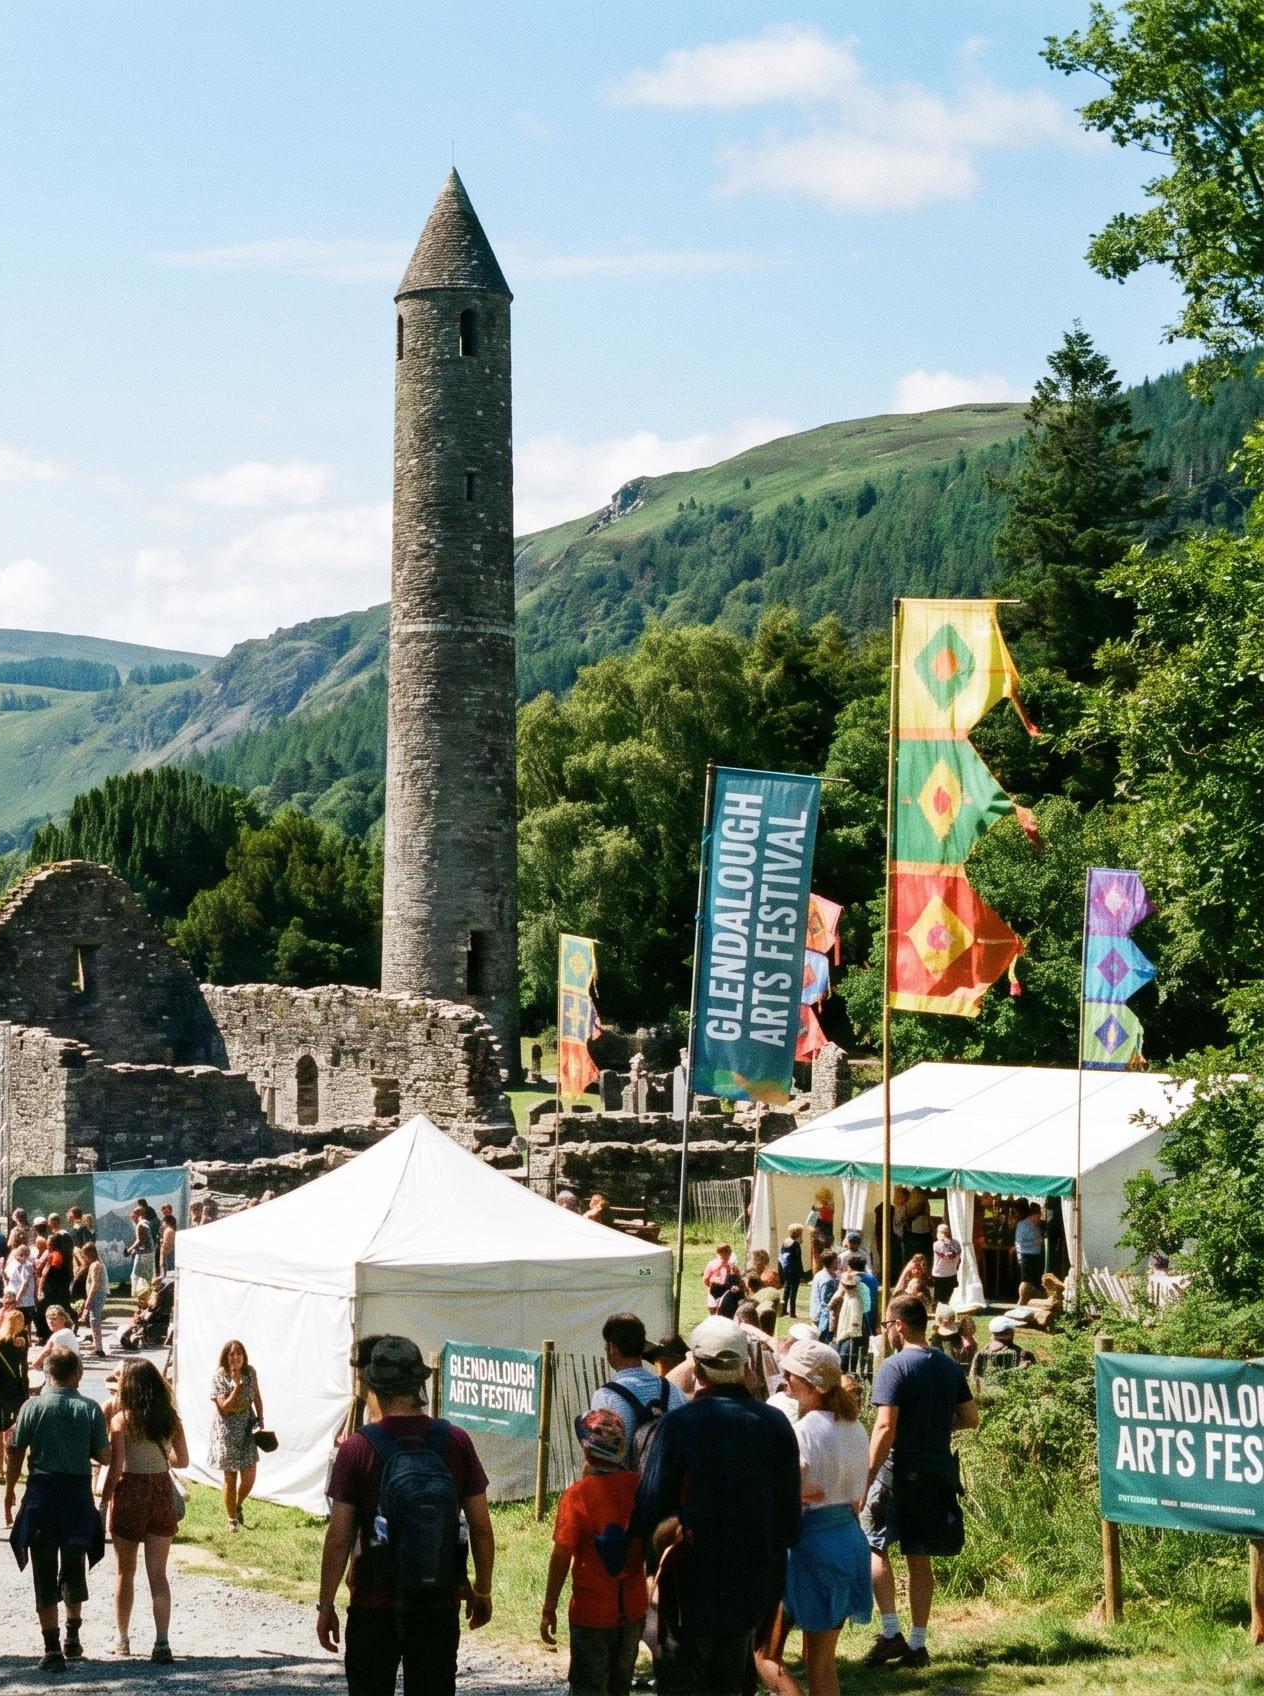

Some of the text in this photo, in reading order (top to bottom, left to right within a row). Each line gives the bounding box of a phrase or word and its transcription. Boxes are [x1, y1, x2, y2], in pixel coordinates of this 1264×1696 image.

[705, 792, 763, 1042] GLENDALOUGH
[749, 811, 808, 1047] ARTS FESTIVAL
[449, 1354, 535, 1388] GLENDALOUGH
[449, 1380, 536, 1415] ARTS FESTIVAL
[1116, 1425, 1196, 1477] ARTS
